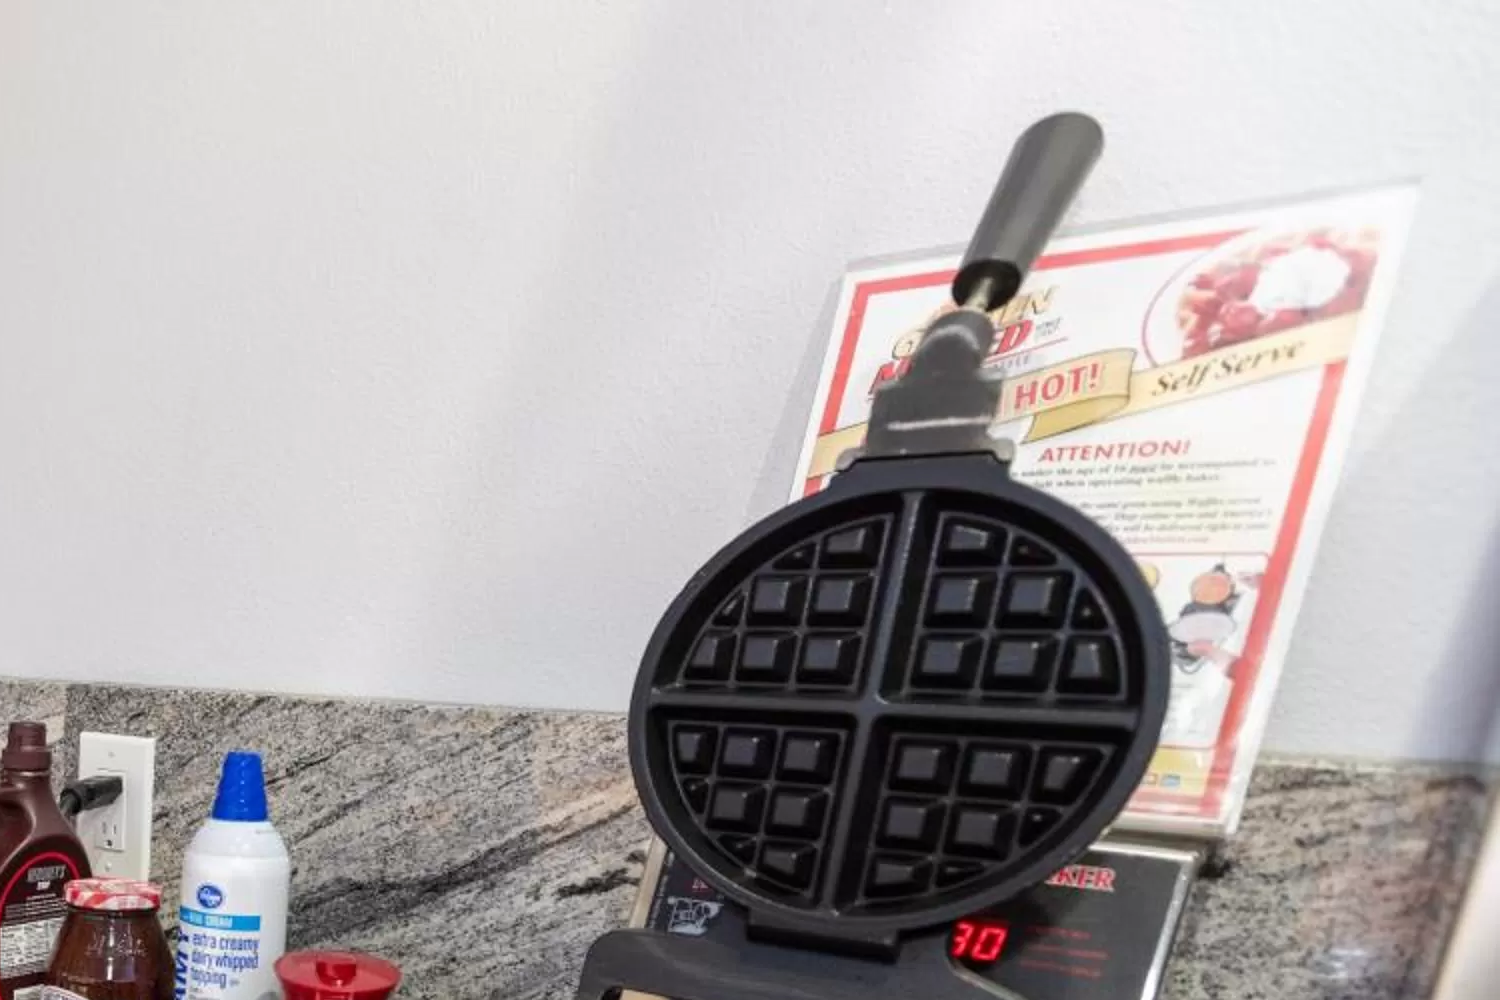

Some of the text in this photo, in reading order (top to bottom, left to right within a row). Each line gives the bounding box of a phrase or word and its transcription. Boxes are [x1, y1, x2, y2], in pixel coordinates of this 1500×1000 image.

[1151, 340, 1306, 397] Self Serve
[1014, 362, 1099, 410] HOT!
[1037, 440, 1192, 463] ATTENTION!
[219, 937, 261, 955] creamy
[951, 921, 1008, 962] 30
[215, 952, 260, 972] whipped
